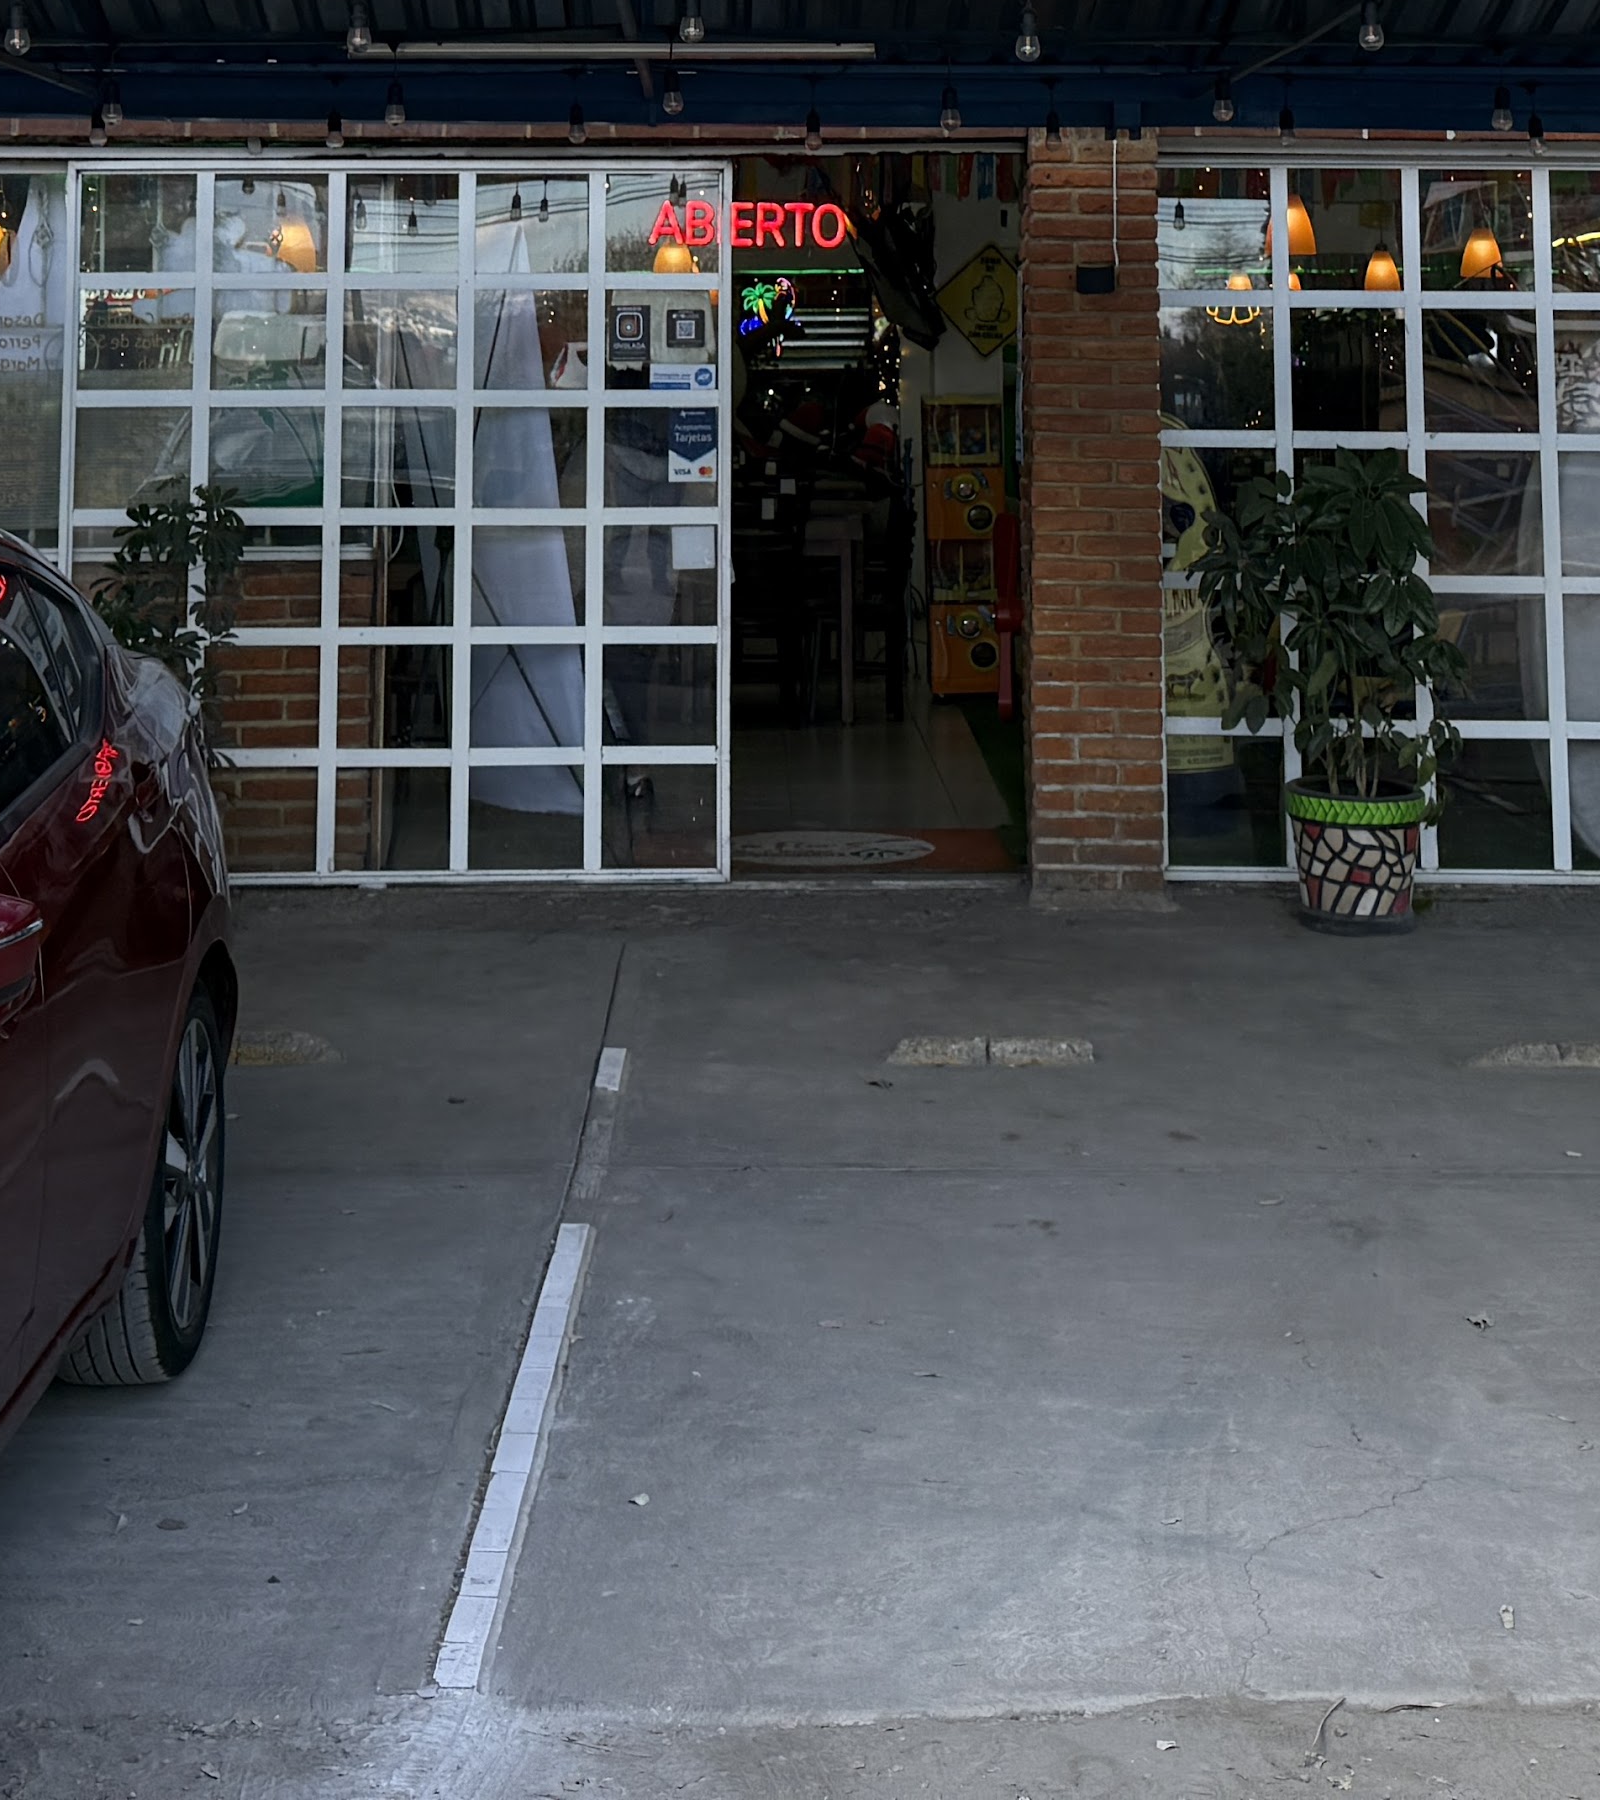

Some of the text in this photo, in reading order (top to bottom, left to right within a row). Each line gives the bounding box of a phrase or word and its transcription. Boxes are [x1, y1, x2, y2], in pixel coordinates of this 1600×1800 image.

[648, 200, 847, 248] ABERTO
[674, 432, 713, 446] Tarjetas
[673, 468, 692, 476] VISA
